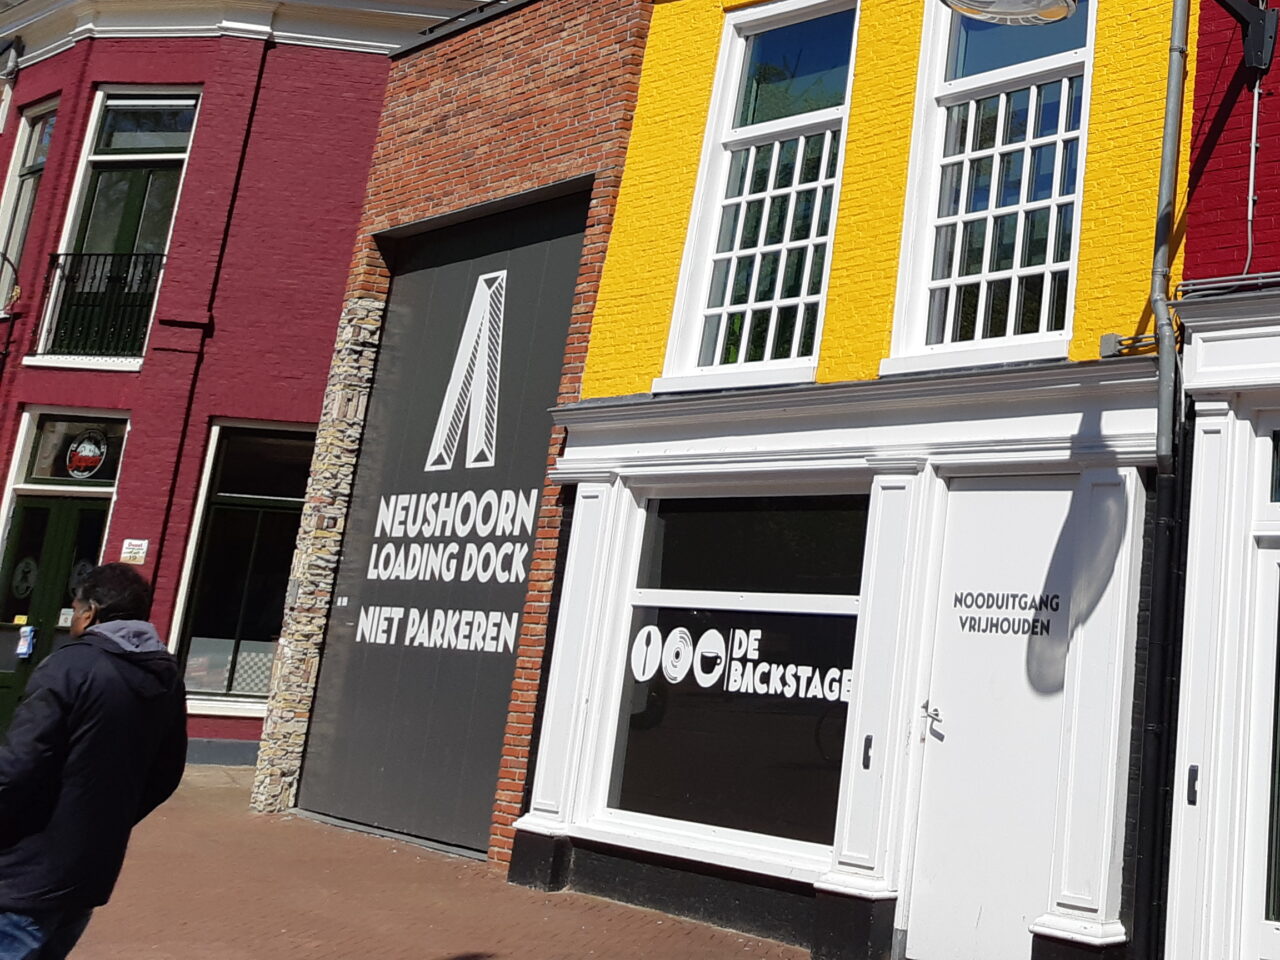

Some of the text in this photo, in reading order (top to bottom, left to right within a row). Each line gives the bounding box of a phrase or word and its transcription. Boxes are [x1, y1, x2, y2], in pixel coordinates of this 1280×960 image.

[374, 488, 539, 538] NEUSHOORN
[367, 542, 529, 584] LOADING DOCK
[953, 591, 1060, 612] NOODUITGANG
[355, 605, 519, 654] NIET PARKEREN
[732, 628, 762, 660] DE
[959, 615, 1051, 637] VRIJHOUDEN
[728, 662, 853, 702] BACKSTAGE
